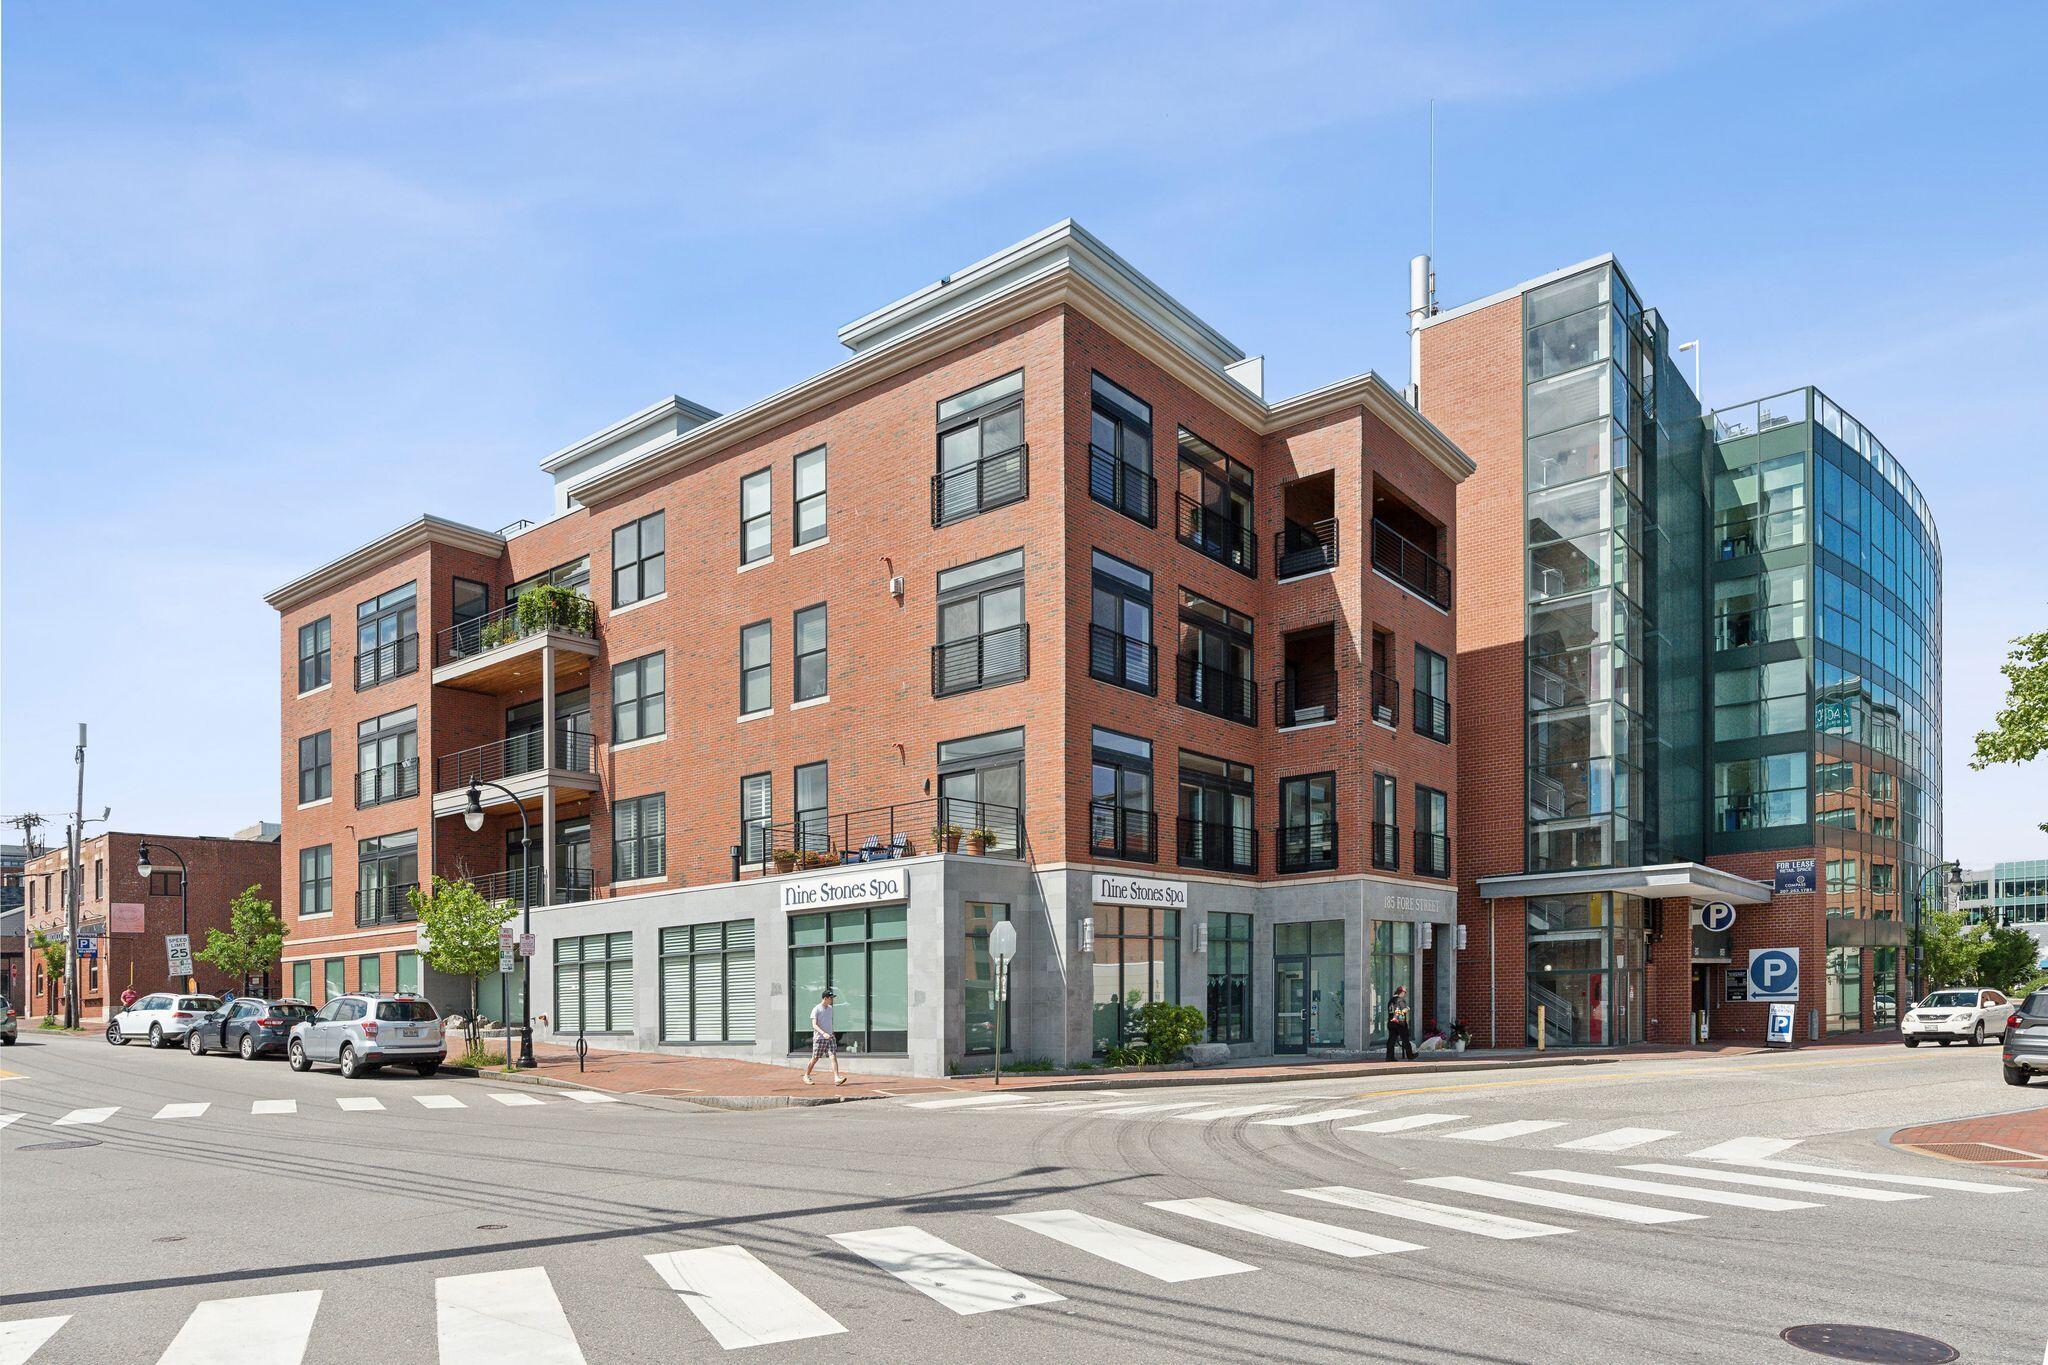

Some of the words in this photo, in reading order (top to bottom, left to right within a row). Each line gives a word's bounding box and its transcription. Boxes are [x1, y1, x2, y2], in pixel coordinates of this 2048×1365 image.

[1776, 862, 1790, 870] FOR
[1792, 860, 1815, 869] LEASE
[820, 882, 867, 902] Stones
[869, 878, 899, 899] Spa
[1130, 881, 1164, 902] Stones
[1165, 887, 1184, 905] Spa
[1384, 895, 1395, 909] 185
[1396, 896, 1414, 911] FORE
[1415, 898, 1440, 913] STREET
[1709, 904, 1728, 928] P
[170, 949, 188, 959] 25
[1763, 959, 1787, 987] P
[1774, 1016, 1789, 1032] P
